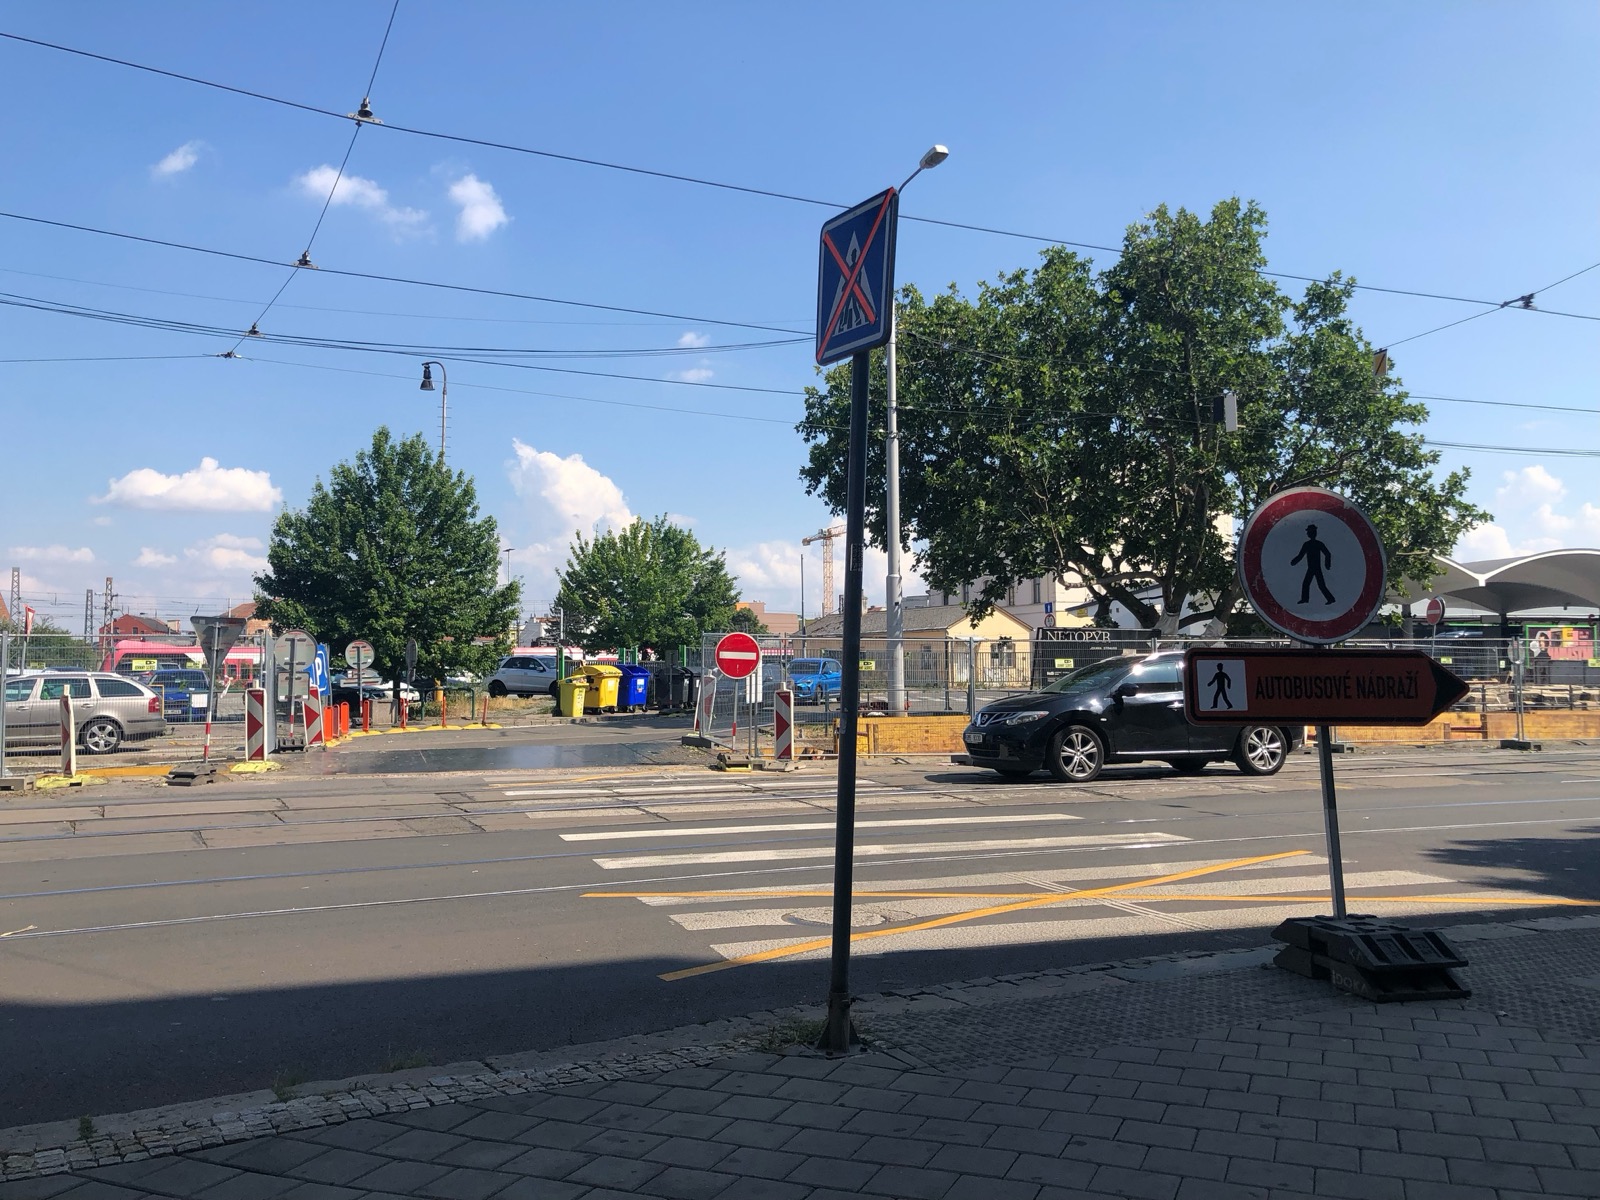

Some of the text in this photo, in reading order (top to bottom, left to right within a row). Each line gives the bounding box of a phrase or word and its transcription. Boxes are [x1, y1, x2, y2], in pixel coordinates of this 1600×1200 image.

[314, 657, 323, 686] P
[1255, 671, 1419, 700] AUTOBUSOVÉ NÁDRAŽÍ
